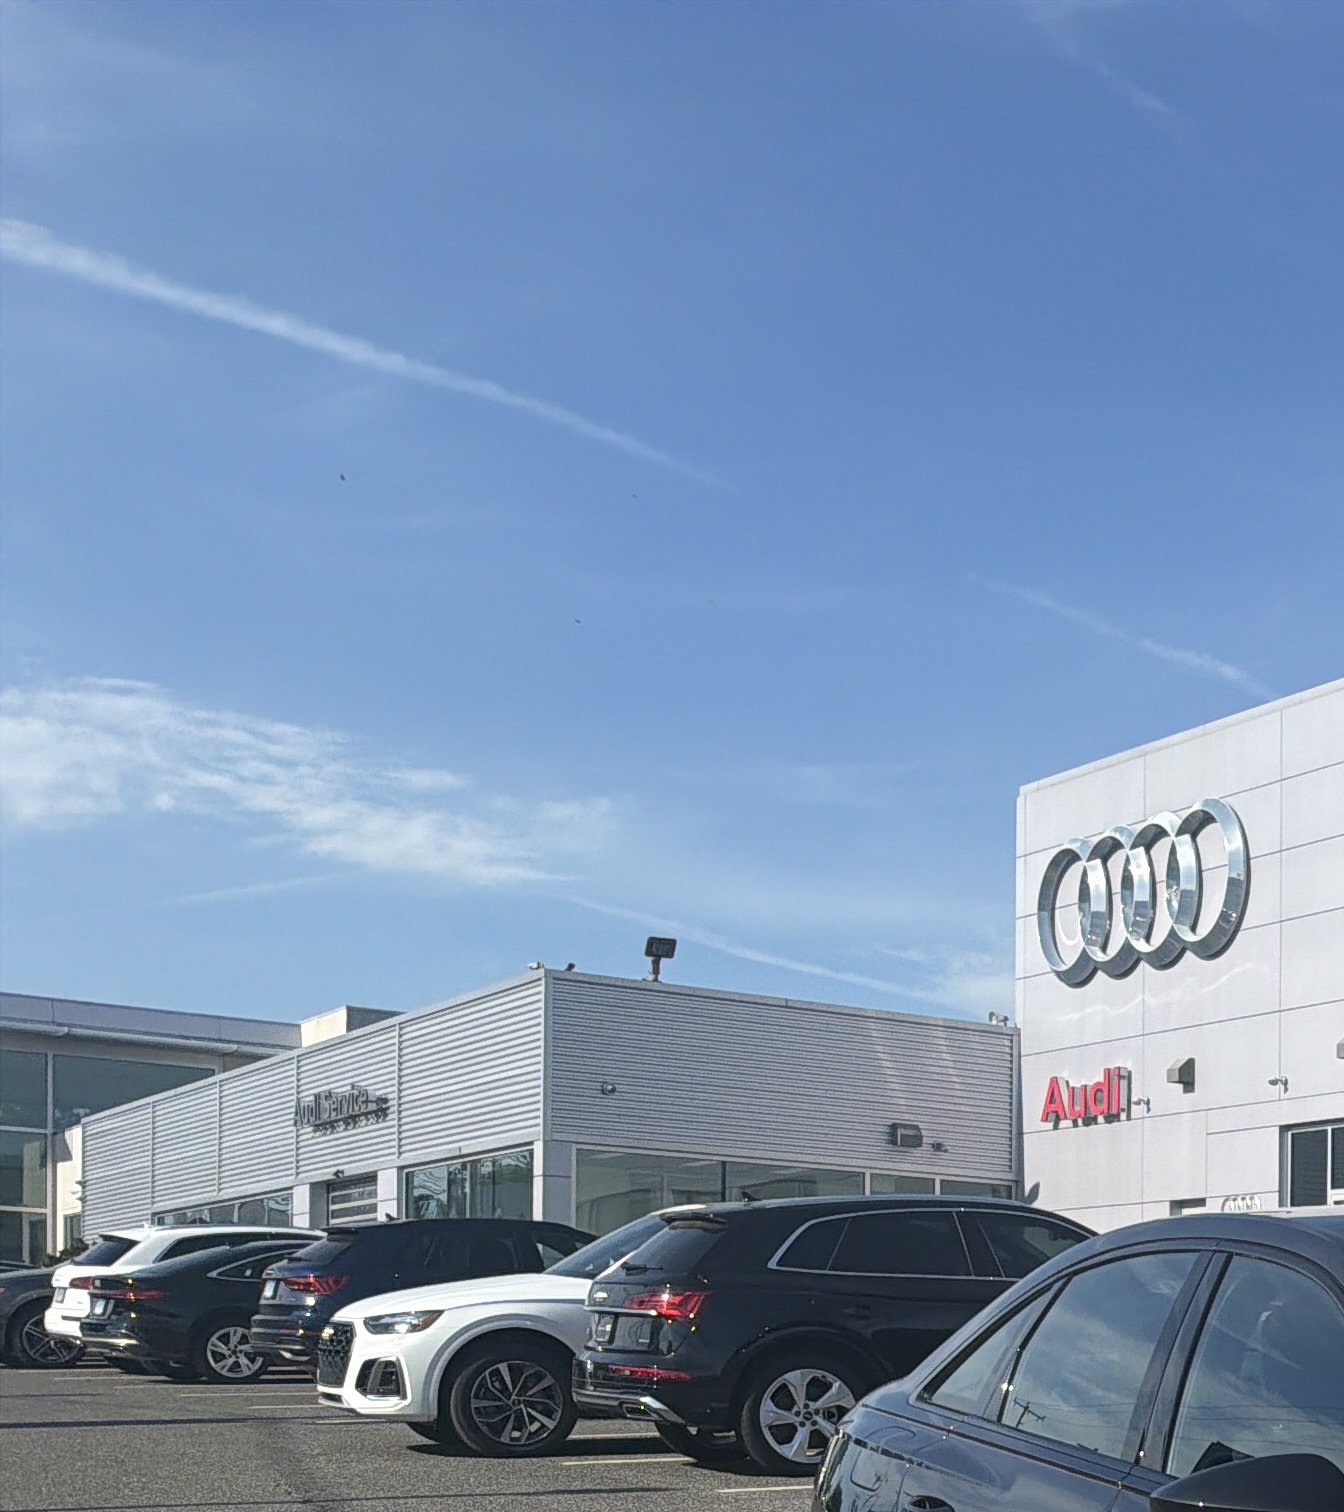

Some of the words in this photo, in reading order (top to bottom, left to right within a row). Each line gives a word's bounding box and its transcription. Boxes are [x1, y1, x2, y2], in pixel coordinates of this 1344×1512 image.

[293, 1091, 320, 1127] Audi
[321, 1083, 369, 1121] Service
[1040, 1066, 1121, 1122] Audi
